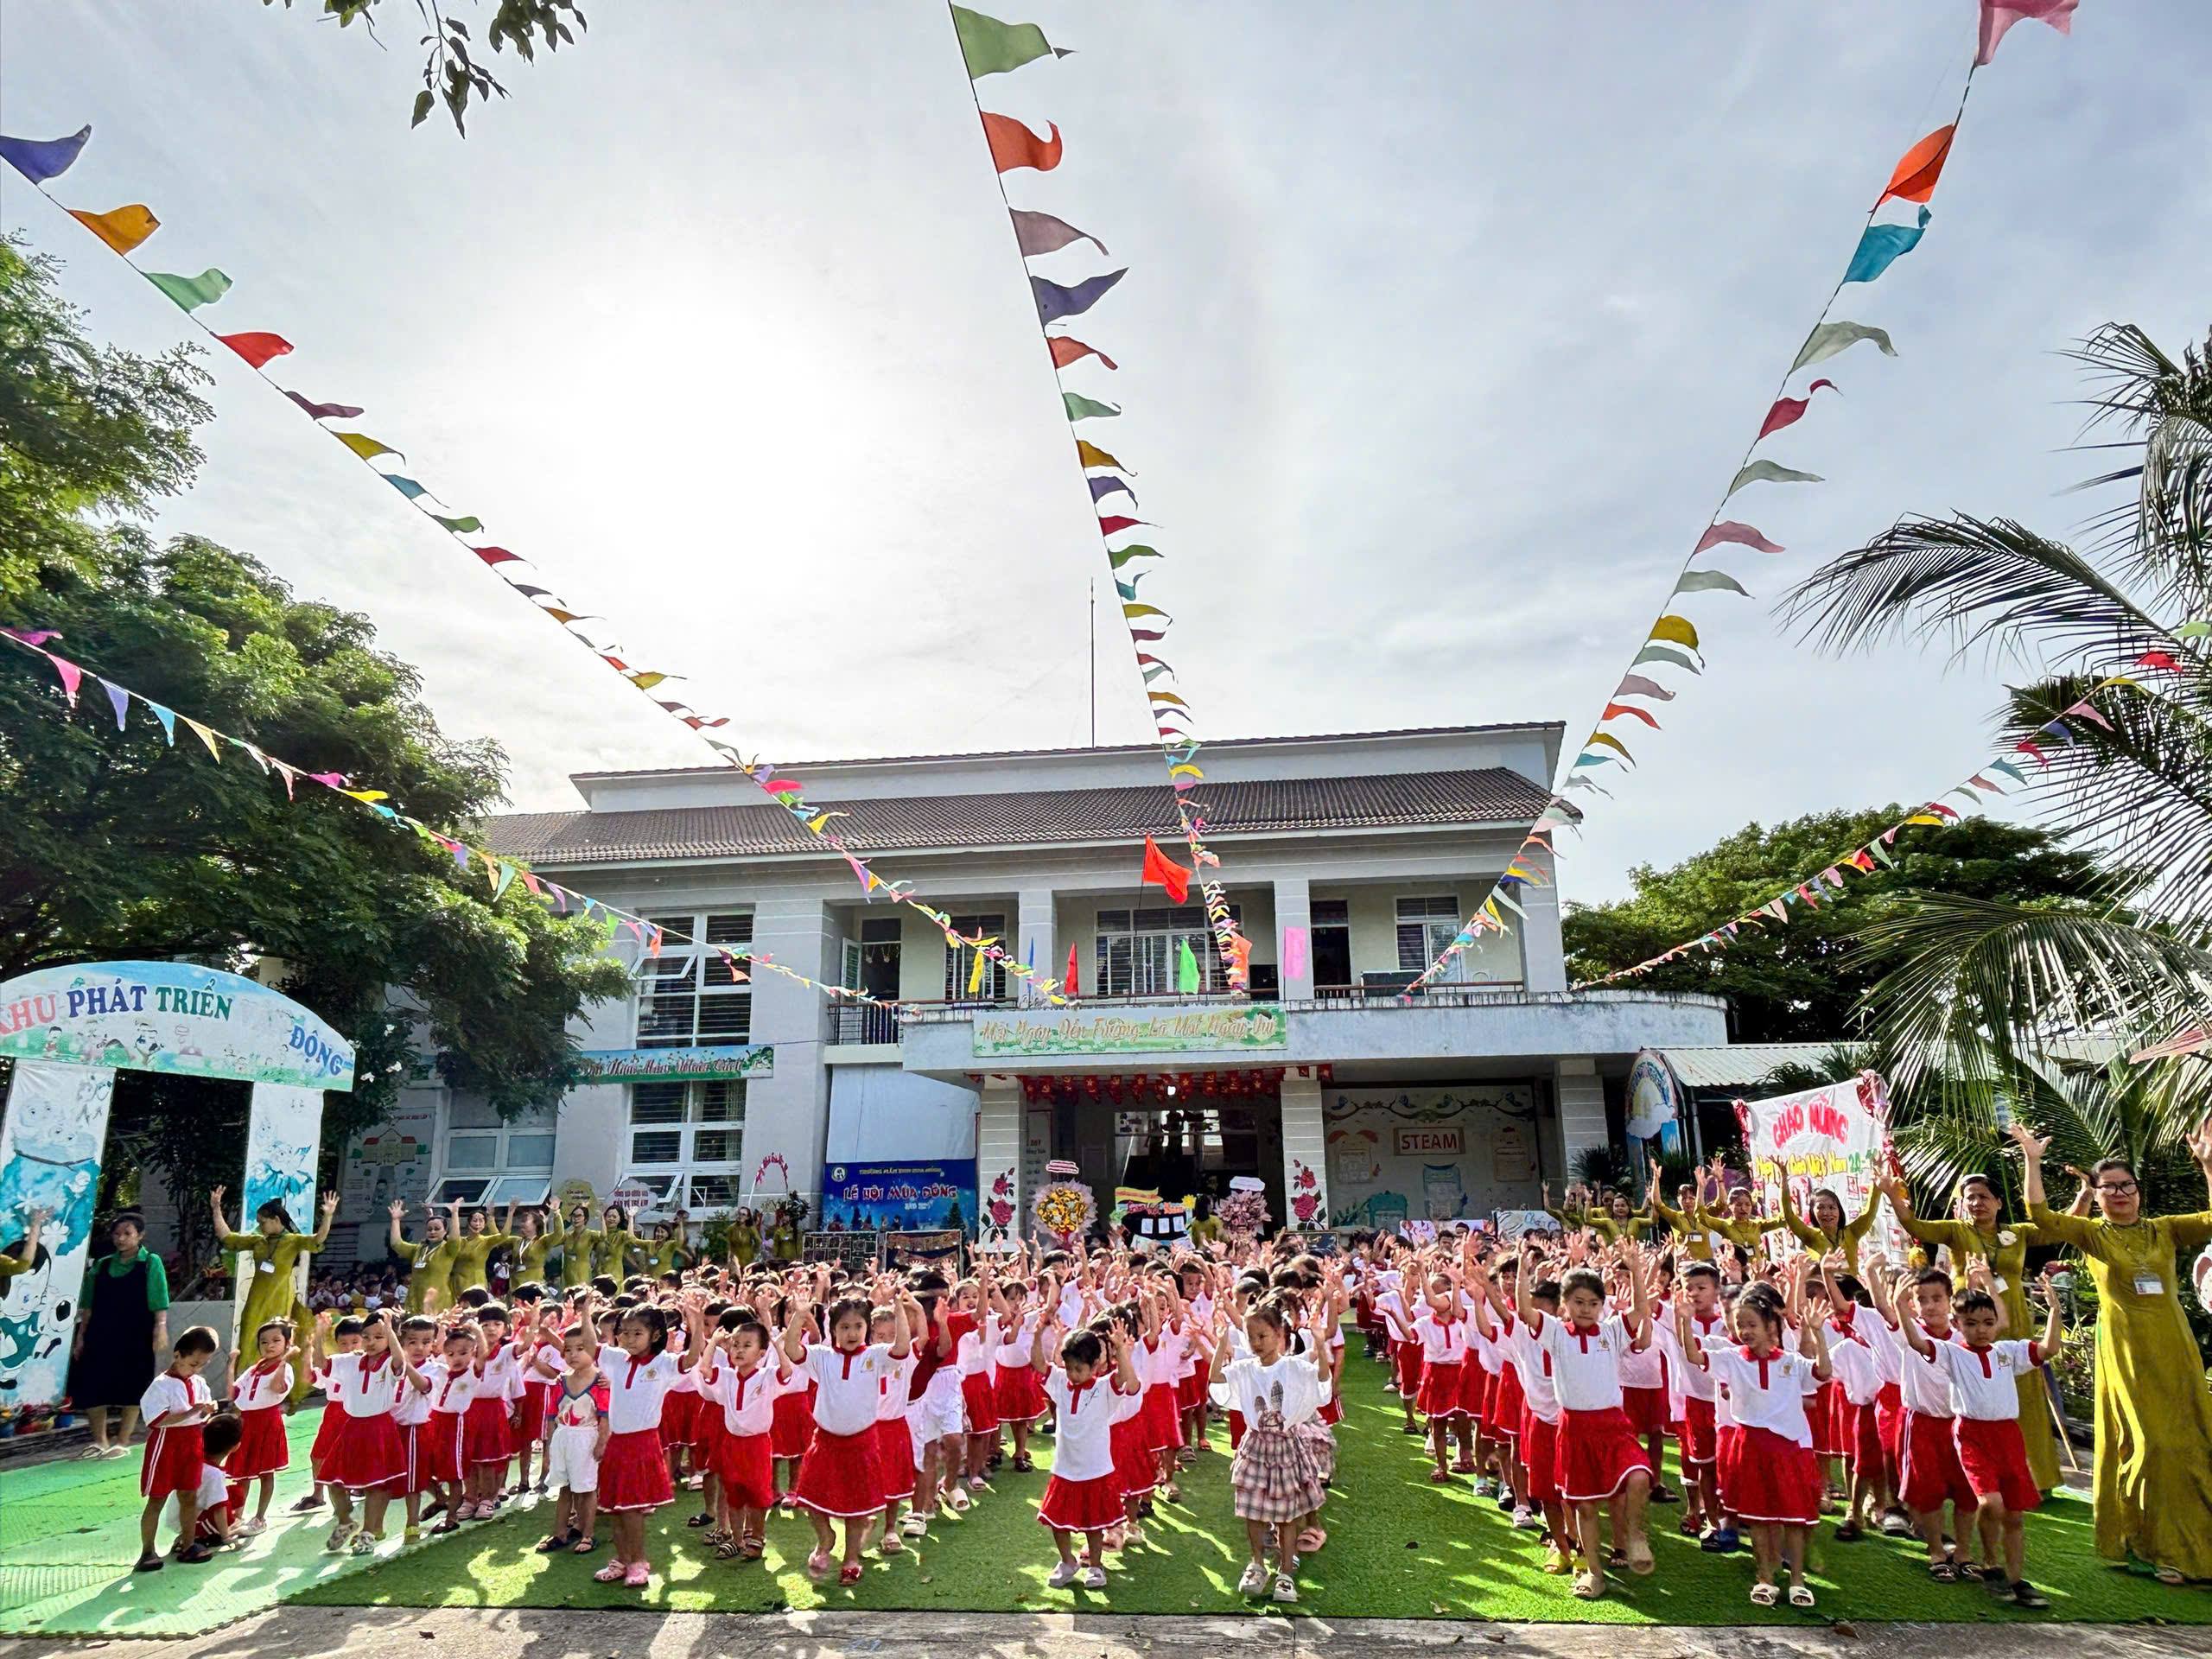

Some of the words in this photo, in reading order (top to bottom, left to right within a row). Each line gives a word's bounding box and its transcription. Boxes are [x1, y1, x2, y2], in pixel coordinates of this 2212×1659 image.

[0, 994, 56, 1035] HU
[67, 978, 147, 1018] PHÁT
[156, 978, 233, 1021] TRIỂN
[289, 1024, 343, 1076] ĐỘNG
[1772, 1102, 1804, 1149] CHÀO
[1402, 1134, 1457, 1150] STEAM
[843, 1184, 859, 1202] LỄ
